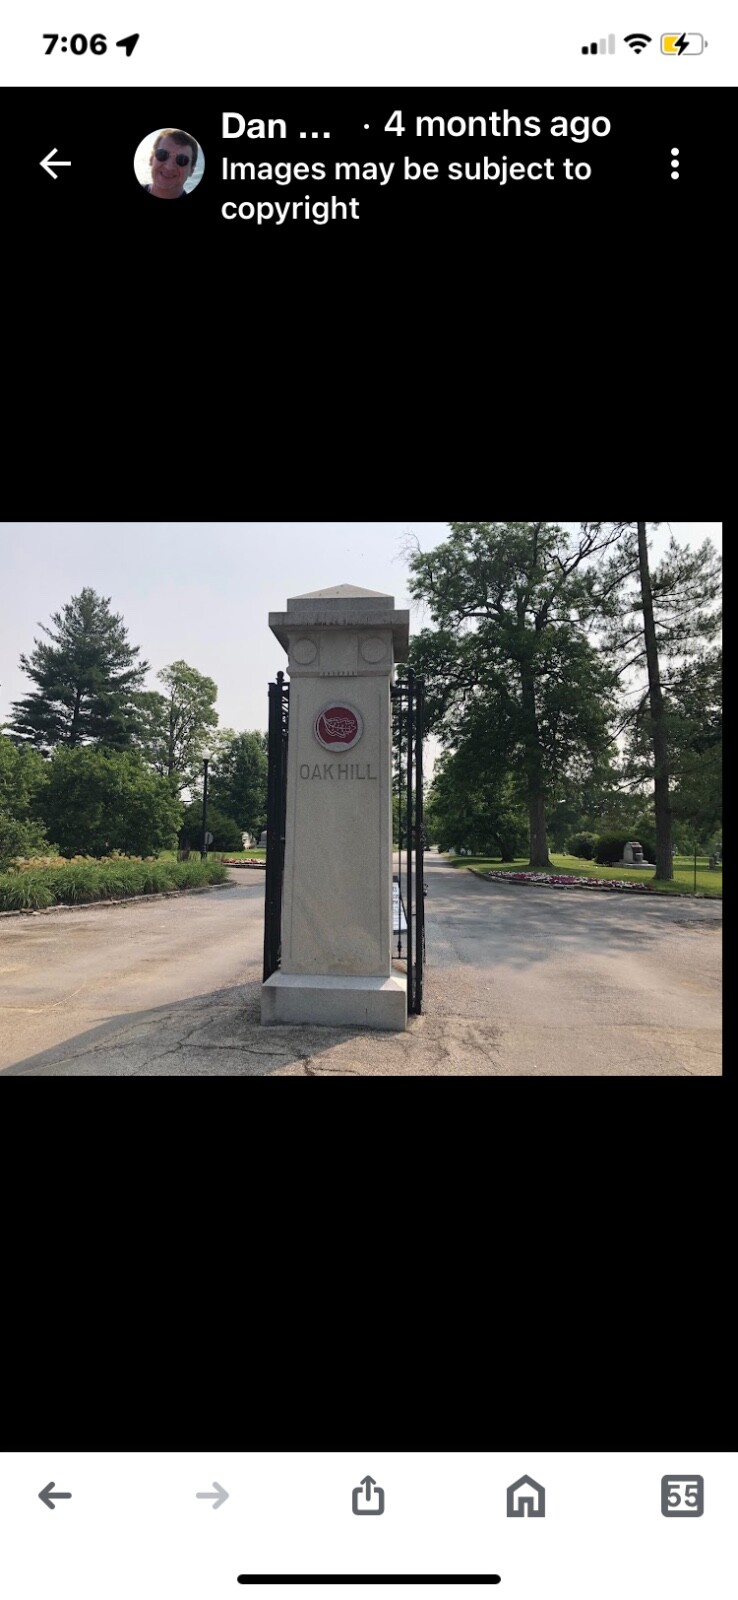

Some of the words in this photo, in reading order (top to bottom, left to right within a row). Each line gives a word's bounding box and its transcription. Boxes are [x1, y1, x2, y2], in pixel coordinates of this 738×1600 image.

[43, 34, 107, 55] 7:06
[222, 112, 287, 138] Dan
[384, 110, 406, 137] 4
[416, 109, 541, 137] months
[551, 116, 611, 144] ago
[222, 158, 326, 186] Images
[335, 163, 395, 186] may
[404, 157, 439, 181] be
[448, 156, 555, 186] subject
[562, 159, 592, 181] to
[222, 195, 360, 226] copyright
[299, 763, 334, 780] OAK
[337, 763, 378, 780] HILL
[667, 1484, 699, 1507] 55
